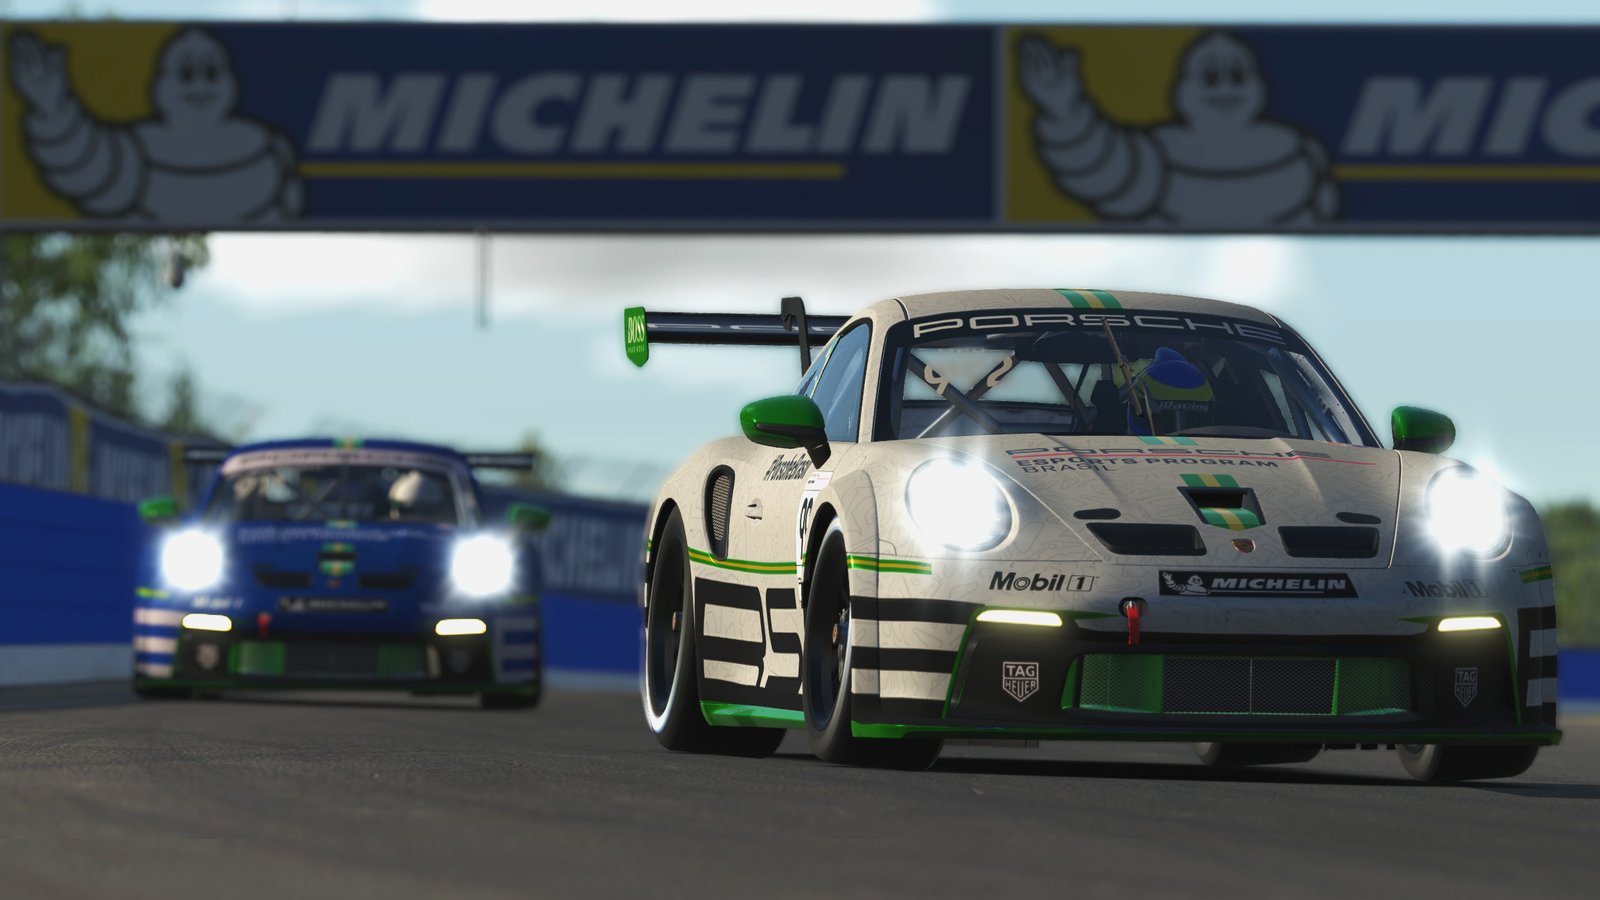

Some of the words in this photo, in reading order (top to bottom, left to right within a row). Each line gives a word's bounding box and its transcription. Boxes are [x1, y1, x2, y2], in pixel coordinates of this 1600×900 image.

[306, 72, 971, 154] MICHELIN
[627, 315, 645, 343] BOSS
[913, 313, 1286, 346] PORSCHE
[1016, 457, 1138, 467] ESPORTS
[1144, 458, 1279, 468] PROGRAM
[1022, 464, 1117, 474] BRASIL
[989, 571, 1065, 591] Mobil
[1211, 578, 1346, 590] MICHELIN
[1006, 665, 1035, 677] TAG
[1457, 671, 1475, 682] TAG
[1005, 680, 1036, 698] HEUER
